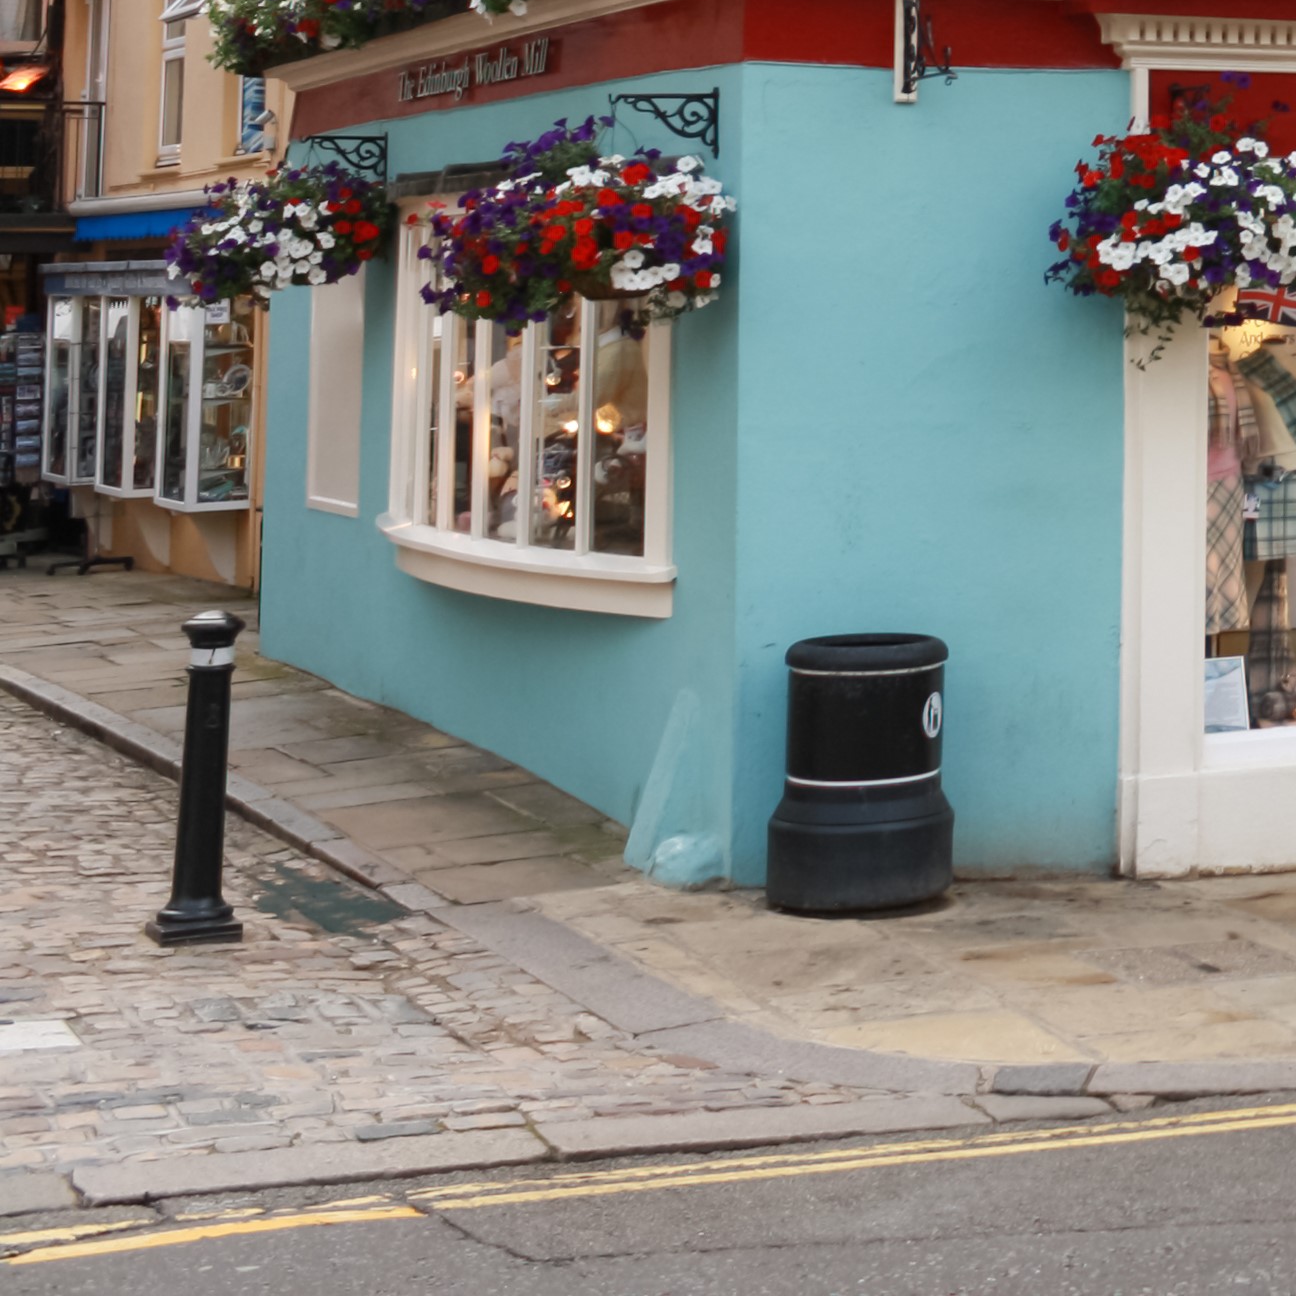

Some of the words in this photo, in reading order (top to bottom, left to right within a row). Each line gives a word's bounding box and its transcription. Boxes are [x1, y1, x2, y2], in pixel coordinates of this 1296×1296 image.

[398, 72, 415, 102] The
[417, 57, 471, 101] Edinburgh
[475, 48, 519, 85] Woollen
[521, 38, 550, 76] Mill
